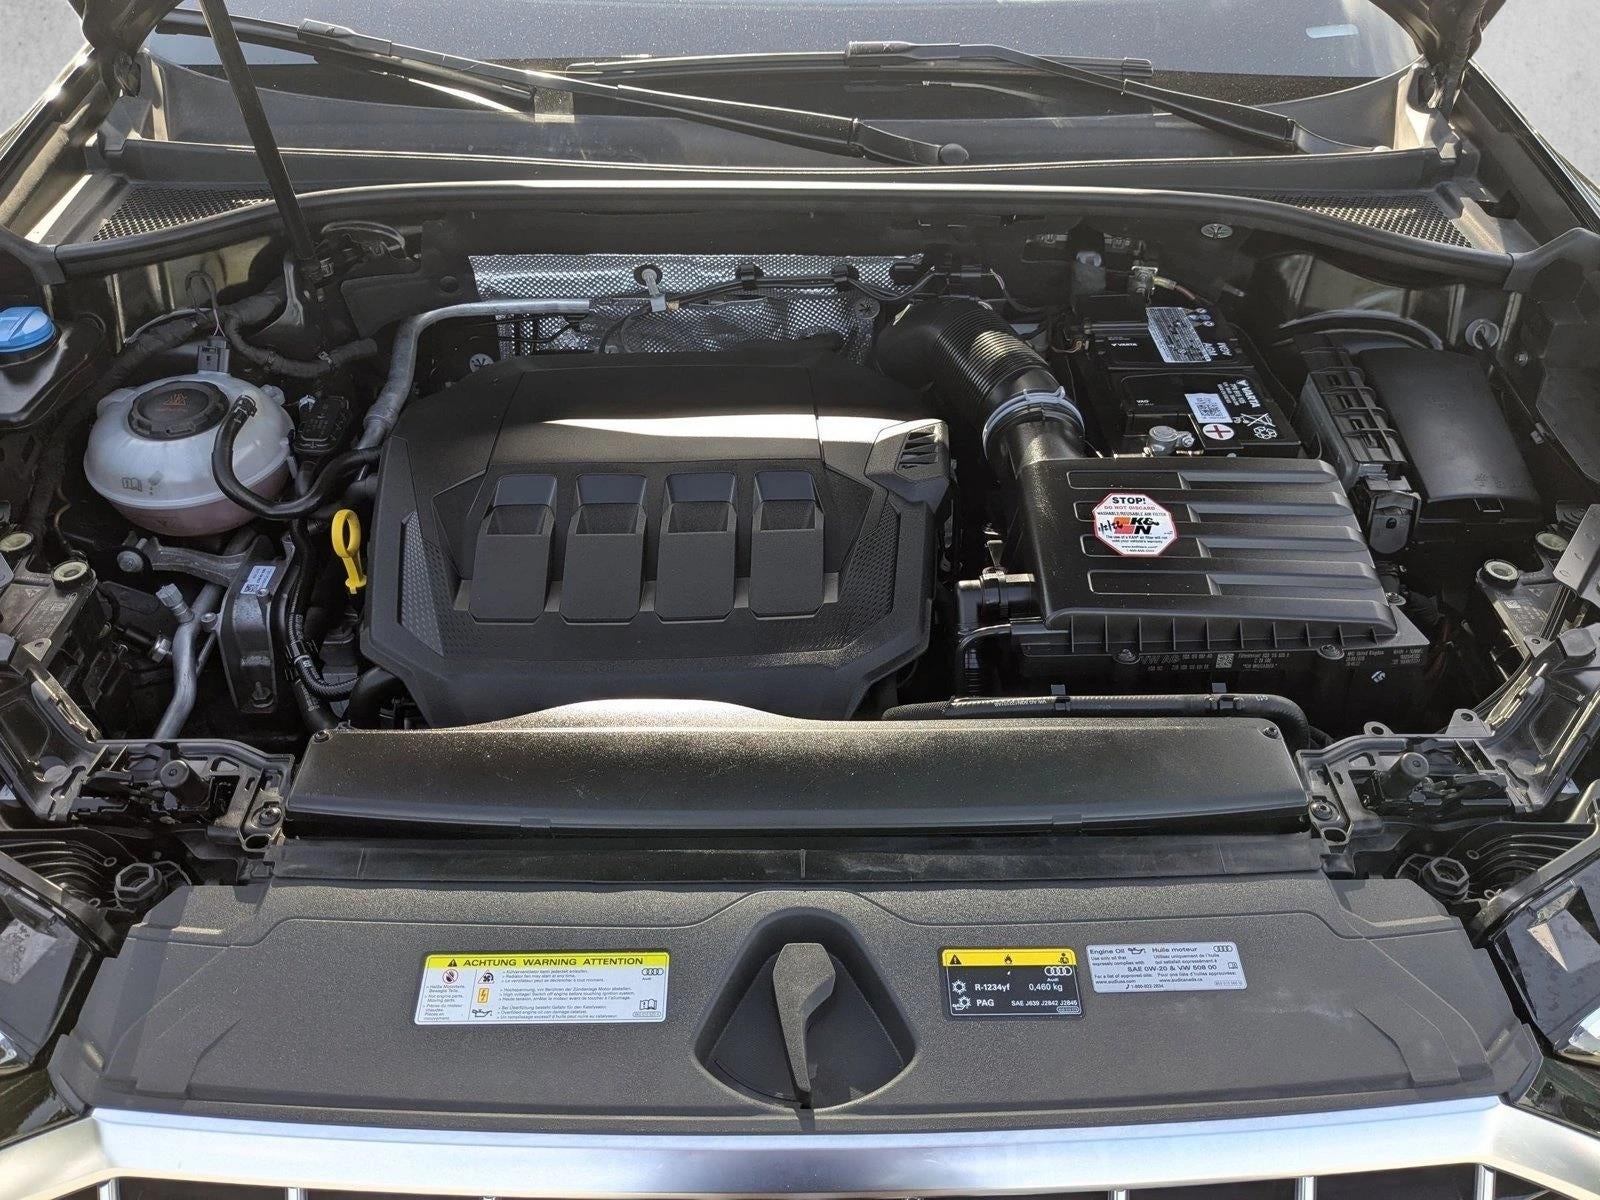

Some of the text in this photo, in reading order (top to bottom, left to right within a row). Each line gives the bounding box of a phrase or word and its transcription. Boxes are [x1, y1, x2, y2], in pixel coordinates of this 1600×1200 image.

[1242, 386, 1261, 408] VARTA
[1112, 496, 1146, 505] STOP!
[463, 957, 644, 967] ACHTUNG WARNING ATTENTION
[974, 983, 1010, 992] R-1234yf
[1029, 983, 1063, 992] 0,460 kg
[976, 999, 995, 1007] PAG
